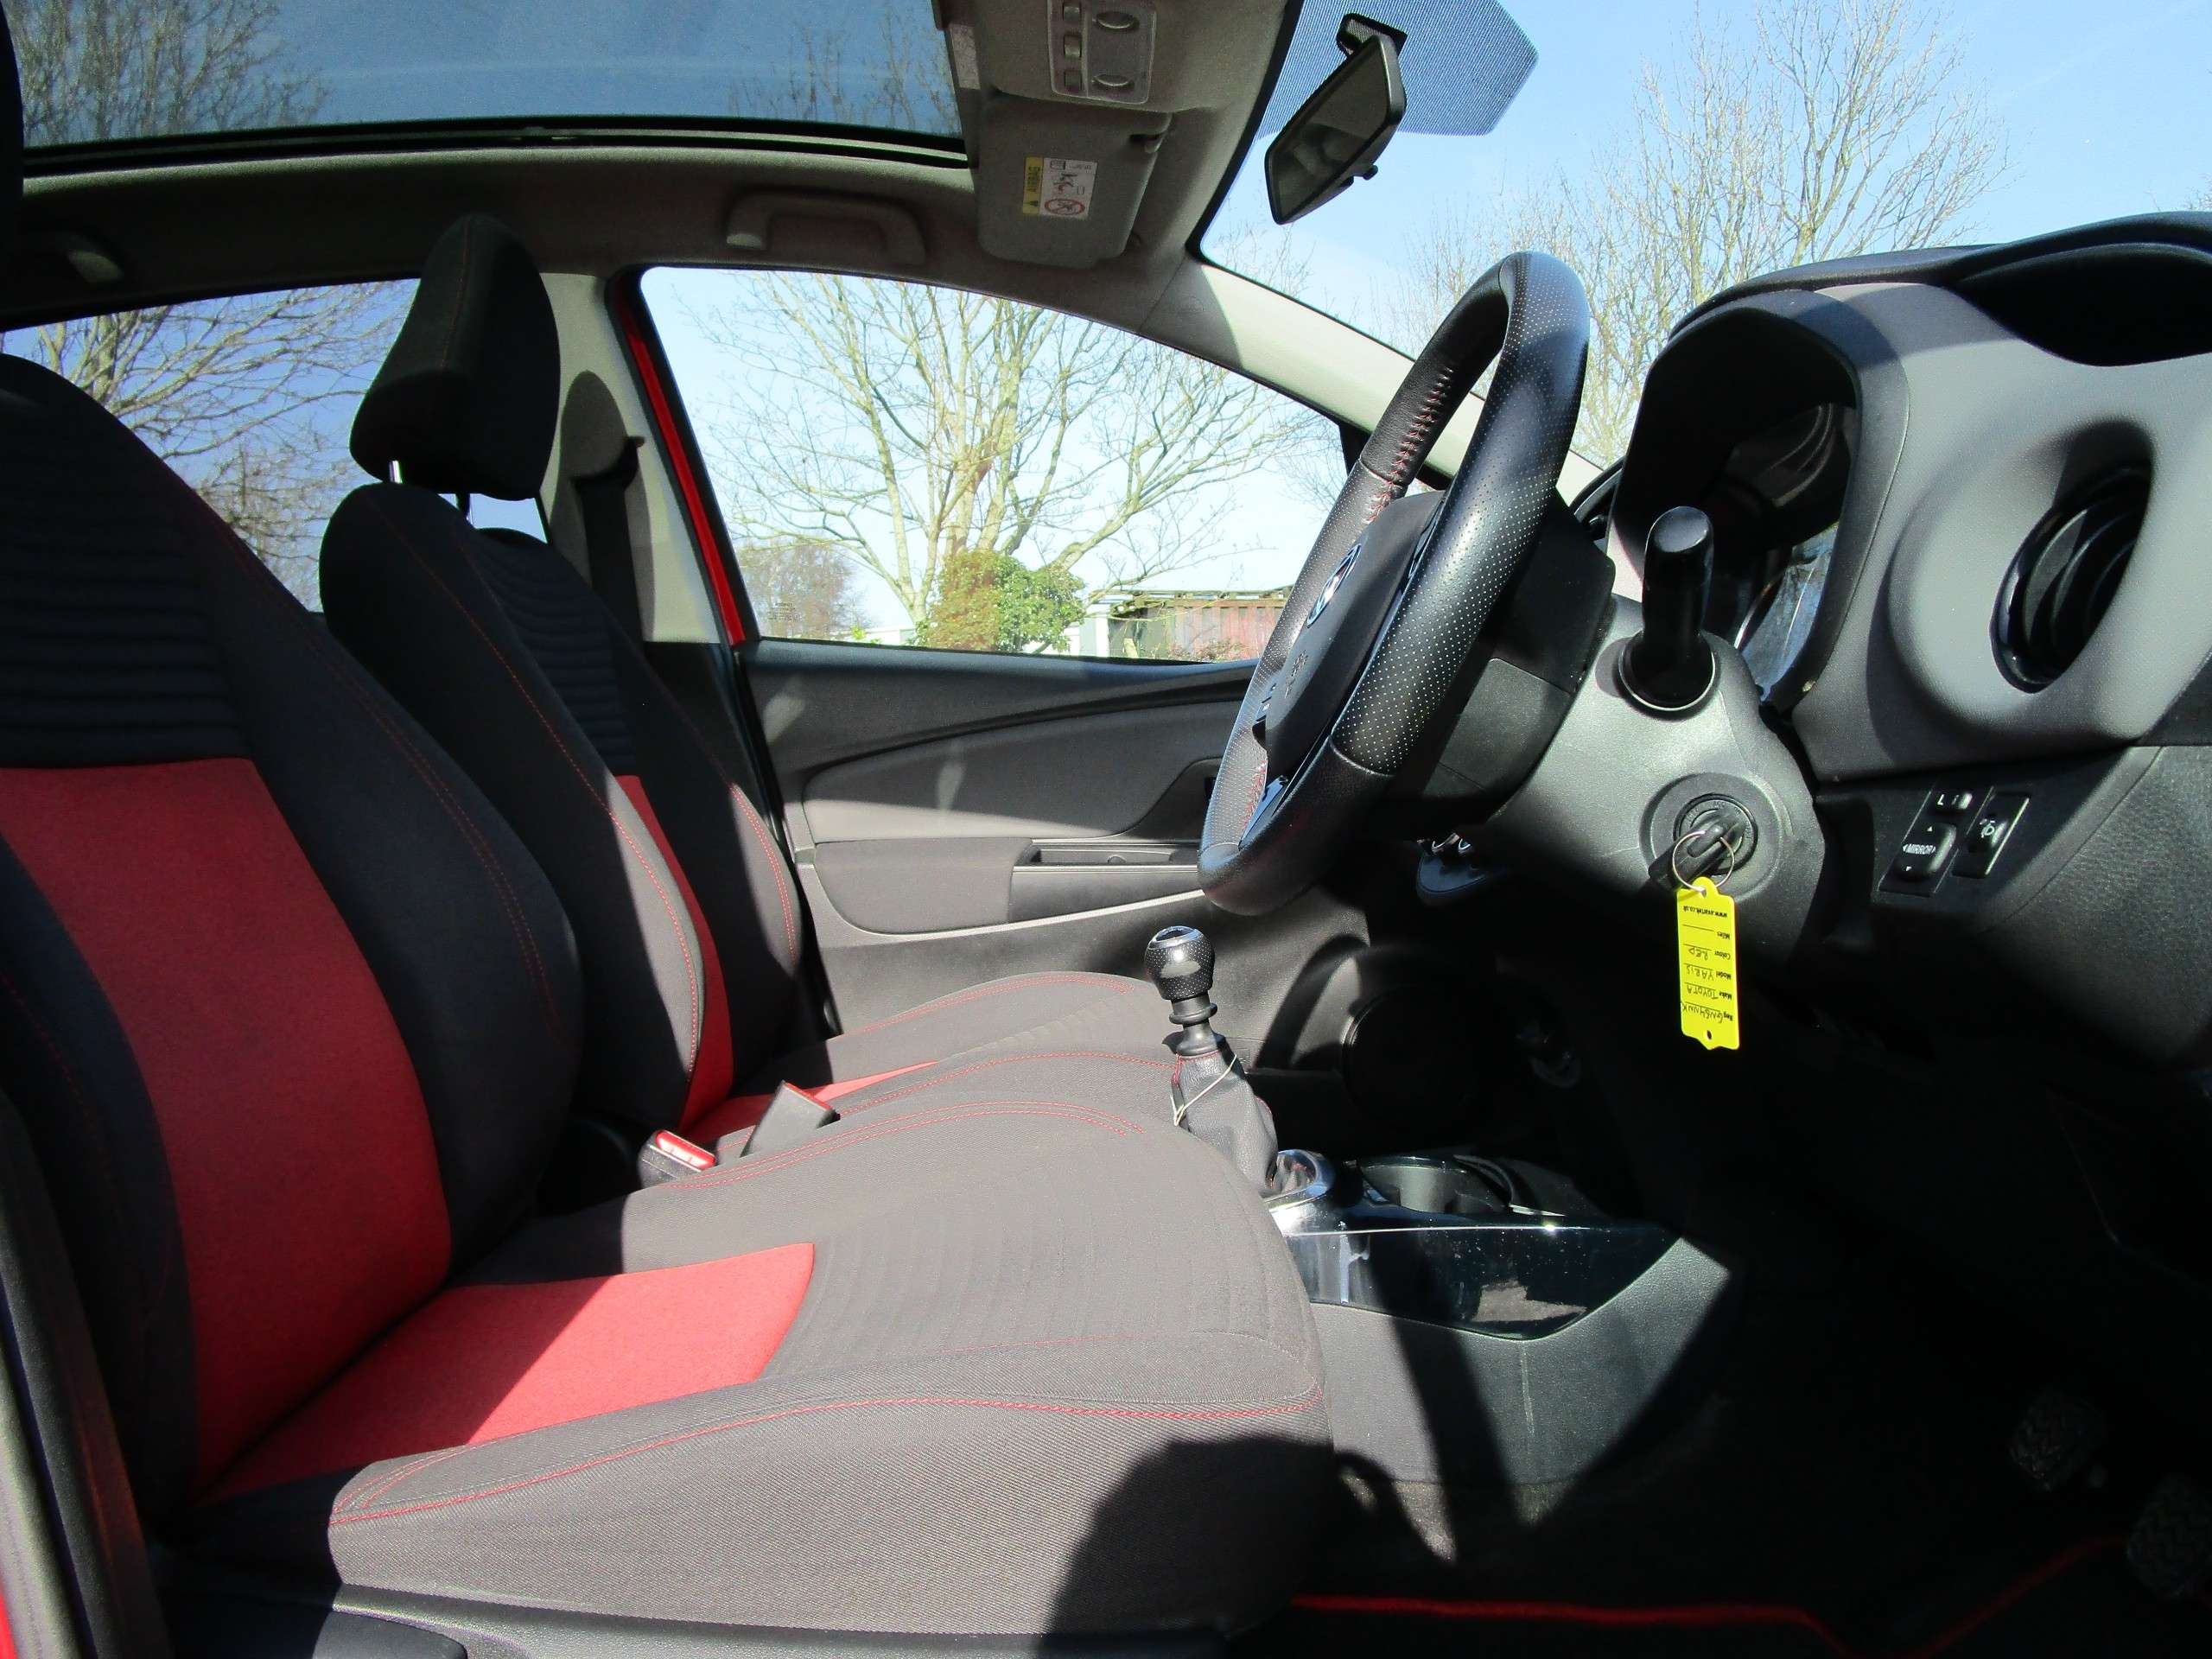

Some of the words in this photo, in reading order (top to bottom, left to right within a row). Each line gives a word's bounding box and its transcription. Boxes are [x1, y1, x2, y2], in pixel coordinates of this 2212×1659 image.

[1905, 843, 1934, 855] MIRROR
[1716, 931, 1730, 940] Miles
[1688, 948, 1708, 961] RED
[1714, 950, 1731, 960] Colour
[1686, 964, 1714, 981] YARIS
[1715, 970, 1732, 981] Model
[1687, 984, 1719, 1000] TOYOTA
[1719, 990, 1732, 1000] Make
[1723, 1010, 1733, 1021] Reg
